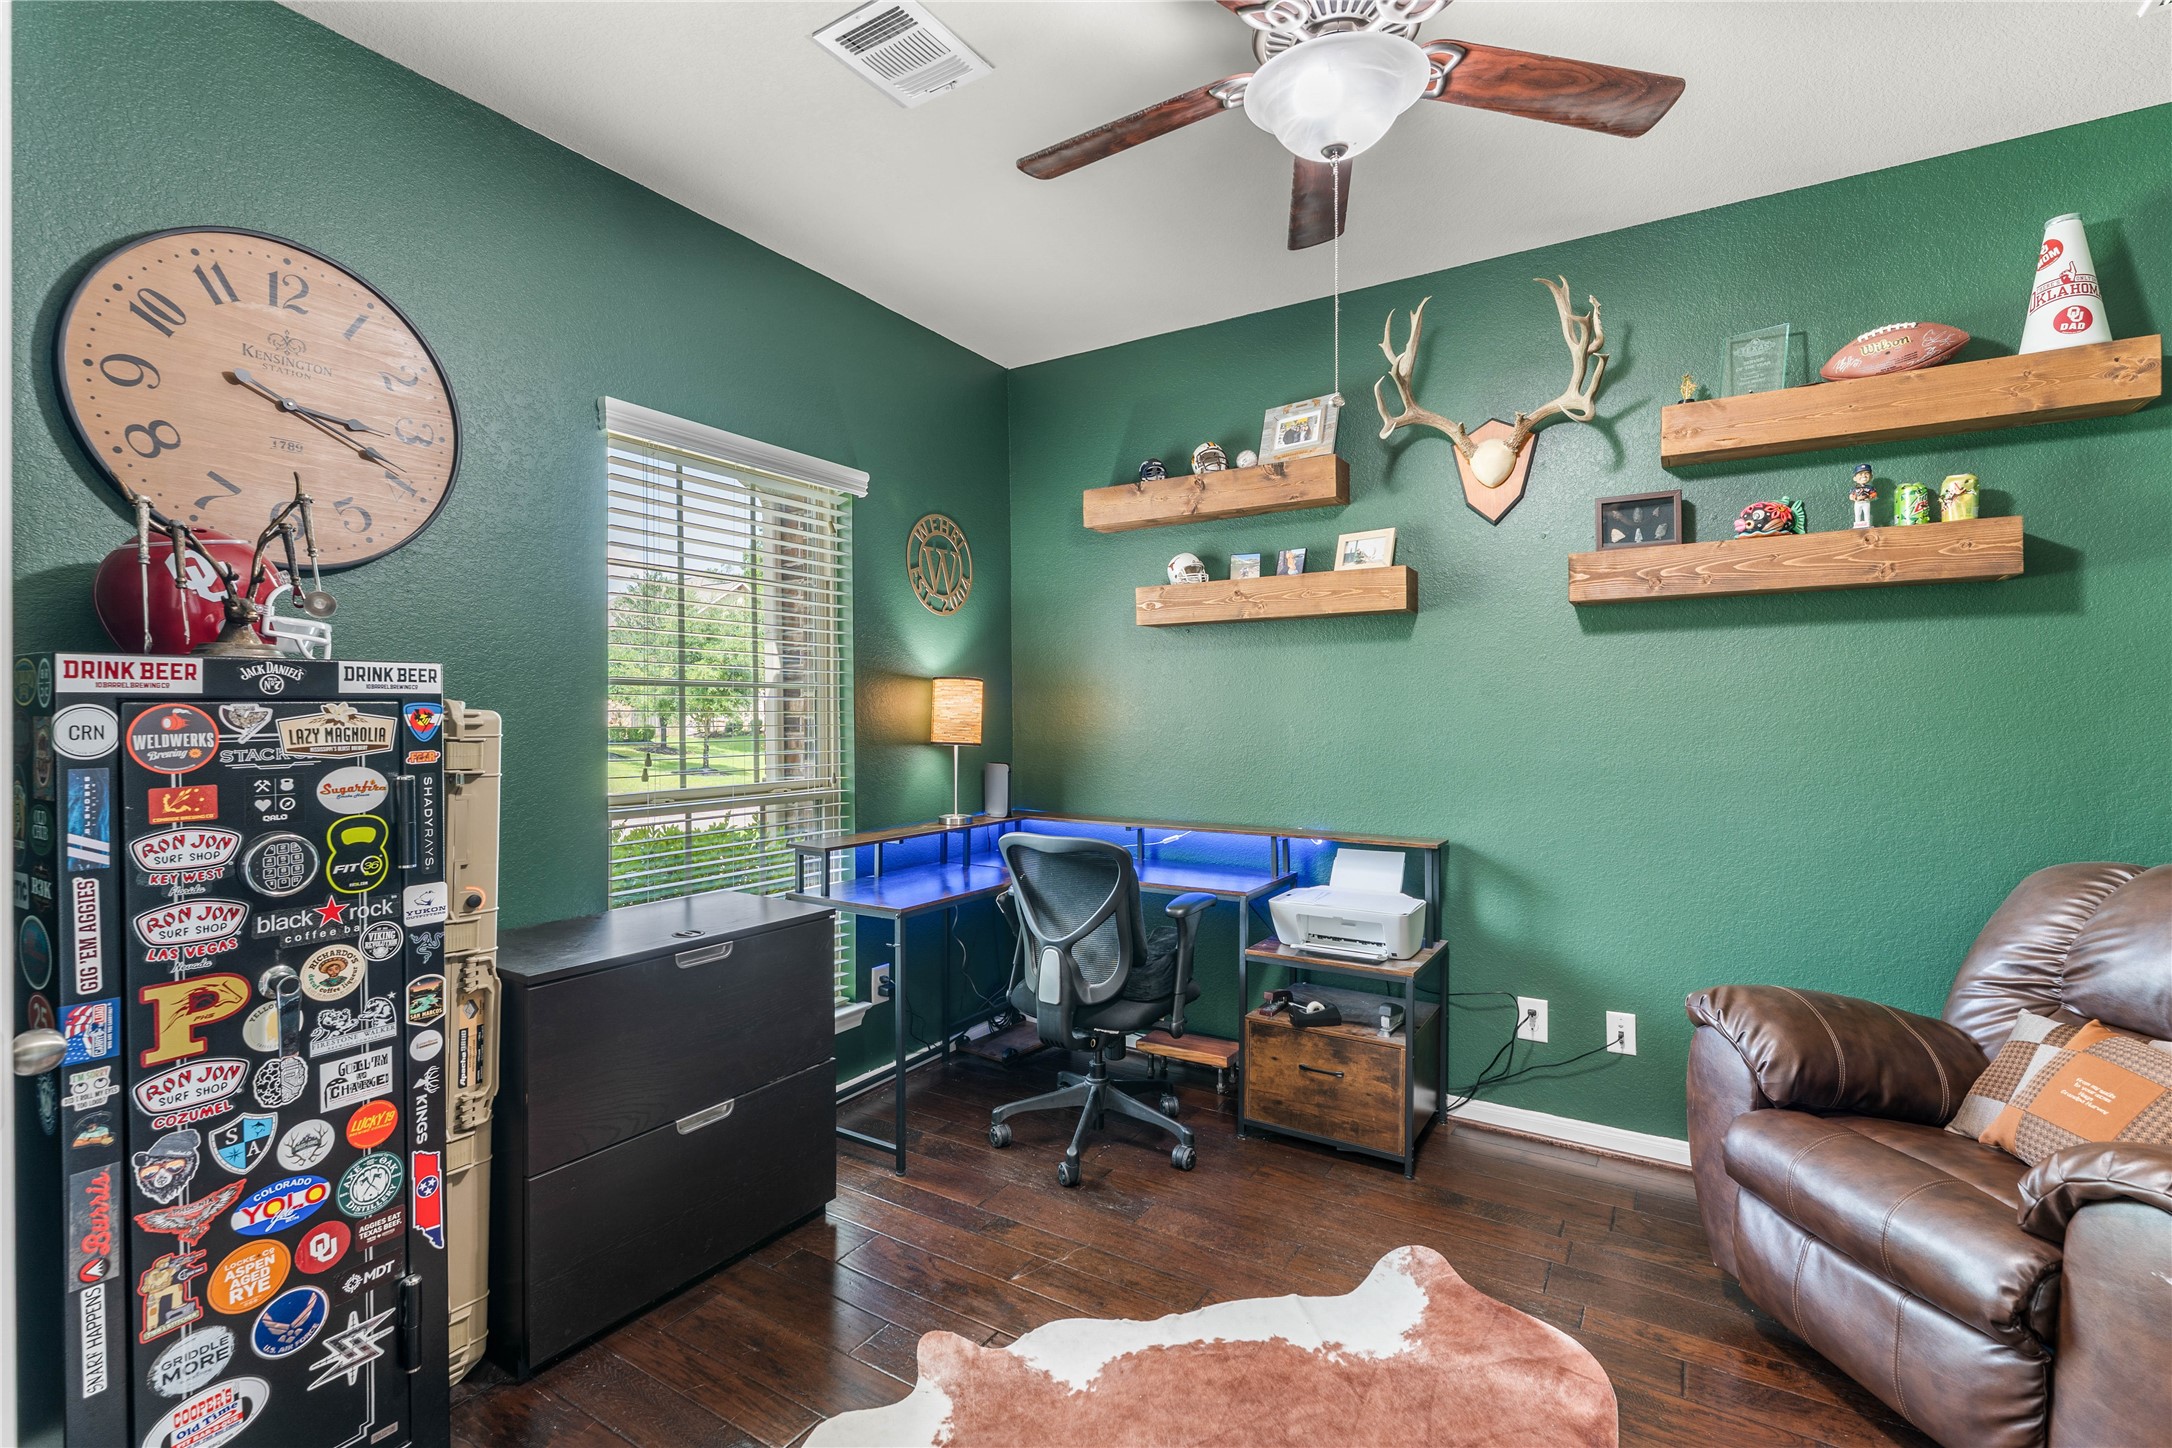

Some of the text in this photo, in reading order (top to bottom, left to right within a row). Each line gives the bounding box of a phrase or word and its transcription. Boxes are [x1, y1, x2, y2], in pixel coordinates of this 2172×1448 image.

[192, 262, 240, 306] 11
[268, 271, 310, 314] 12
[2030, 284, 2101, 313] OKLAHOM
[130, 288, 186, 338] 10
[343, 313, 369, 341] 1
[1860, 336, 1911, 356] Wilson
[100, 354, 160, 389] 9
[242, 342, 332, 378] KENSINGTON
[262, 362, 312, 380] STATION
[380, 365, 419, 392] 2
[125, 420, 181, 458] 8
[395, 418, 434, 447] 3
[194, 470, 242, 510] 7
[384, 470, 418, 502] 4
[334, 497, 372, 533] 5
[63, 660, 134, 679] DRINK
[140, 662, 197, 680] BEER
[240, 662, 304, 681] JACK DANIEL'S
[344, 666, 437, 683] DRINK BEER
[69, 725, 104, 740] CRN
[133, 732, 214, 751] WELDWERKS
[288, 726, 386, 746] LAZY MAGNOLIA
[147, 749, 188, 762] Brewing
[320, 780, 386, 795] Sugarfire
[142, 834, 232, 858] RON JON
[154, 851, 220, 865] SURF SHOP
[150, 868, 225, 885] KEY WEST
[333, 861, 379, 874] FIT 36
[147, 906, 240, 933] RON JON
[257, 900, 393, 933] black rock
[406, 906, 446, 916] YUKON
[78, 880, 98, 992] GIG 'EM AGGIES
[159, 924, 227, 939] SURF SHOP
[285, 930, 336, 943] coffee
[369, 930, 396, 941] VIKING
[147, 939, 238, 962] LAS VEGAS
[309, 950, 359, 970] RICHARDO'S
[308, 974, 320, 990] decaf
[249, 1004, 278, 1023] YELLO
[422, 1008, 443, 1019] MARCOS
[312, 1024, 396, 1051] FIRESTONE WALKER
[147, 1064, 240, 1102] RON JON
[159, 1082, 228, 1107] SURF SHOP
[153, 1100, 232, 1129] COZUMEL
[351, 1113, 383, 1132] LUCKY
[416, 1094, 428, 1144] KINGS
[225, 1127, 238, 1145] S
[247, 1141, 261, 1156] A
[343, 1156, 398, 1189] AXE OAK
[254, 1177, 312, 1202] COLORADO
[346, 1184, 396, 1212] DISTILLERY
[80, 1170, 111, 1256] Burris
[172, 1197, 215, 1217] PHOENIX
[242, 1184, 326, 1224] YOLO
[359, 1217, 387, 1234] AGGIES
[387, 1212, 402, 1221] EAT
[359, 1226, 382, 1240] TEXAS
[224, 1253, 256, 1270] LOCKE
[224, 1254, 275, 1283] ASPEN
[363, 1260, 395, 1284] MDT
[229, 1269, 271, 1292] AGED
[229, 1278, 272, 1306] RYE
[86, 1287, 102, 1350] HAPPENS
[278, 1342, 292, 1353] AIR
[292, 1322, 319, 1350] FORCE
[161, 1336, 230, 1371] GRIDDLE
[162, 1348, 230, 1386] MORE
[174, 1388, 232, 1428] COOPER'S
[176, 1424, 200, 1440] Old
[203, 1402, 238, 1424] Time
